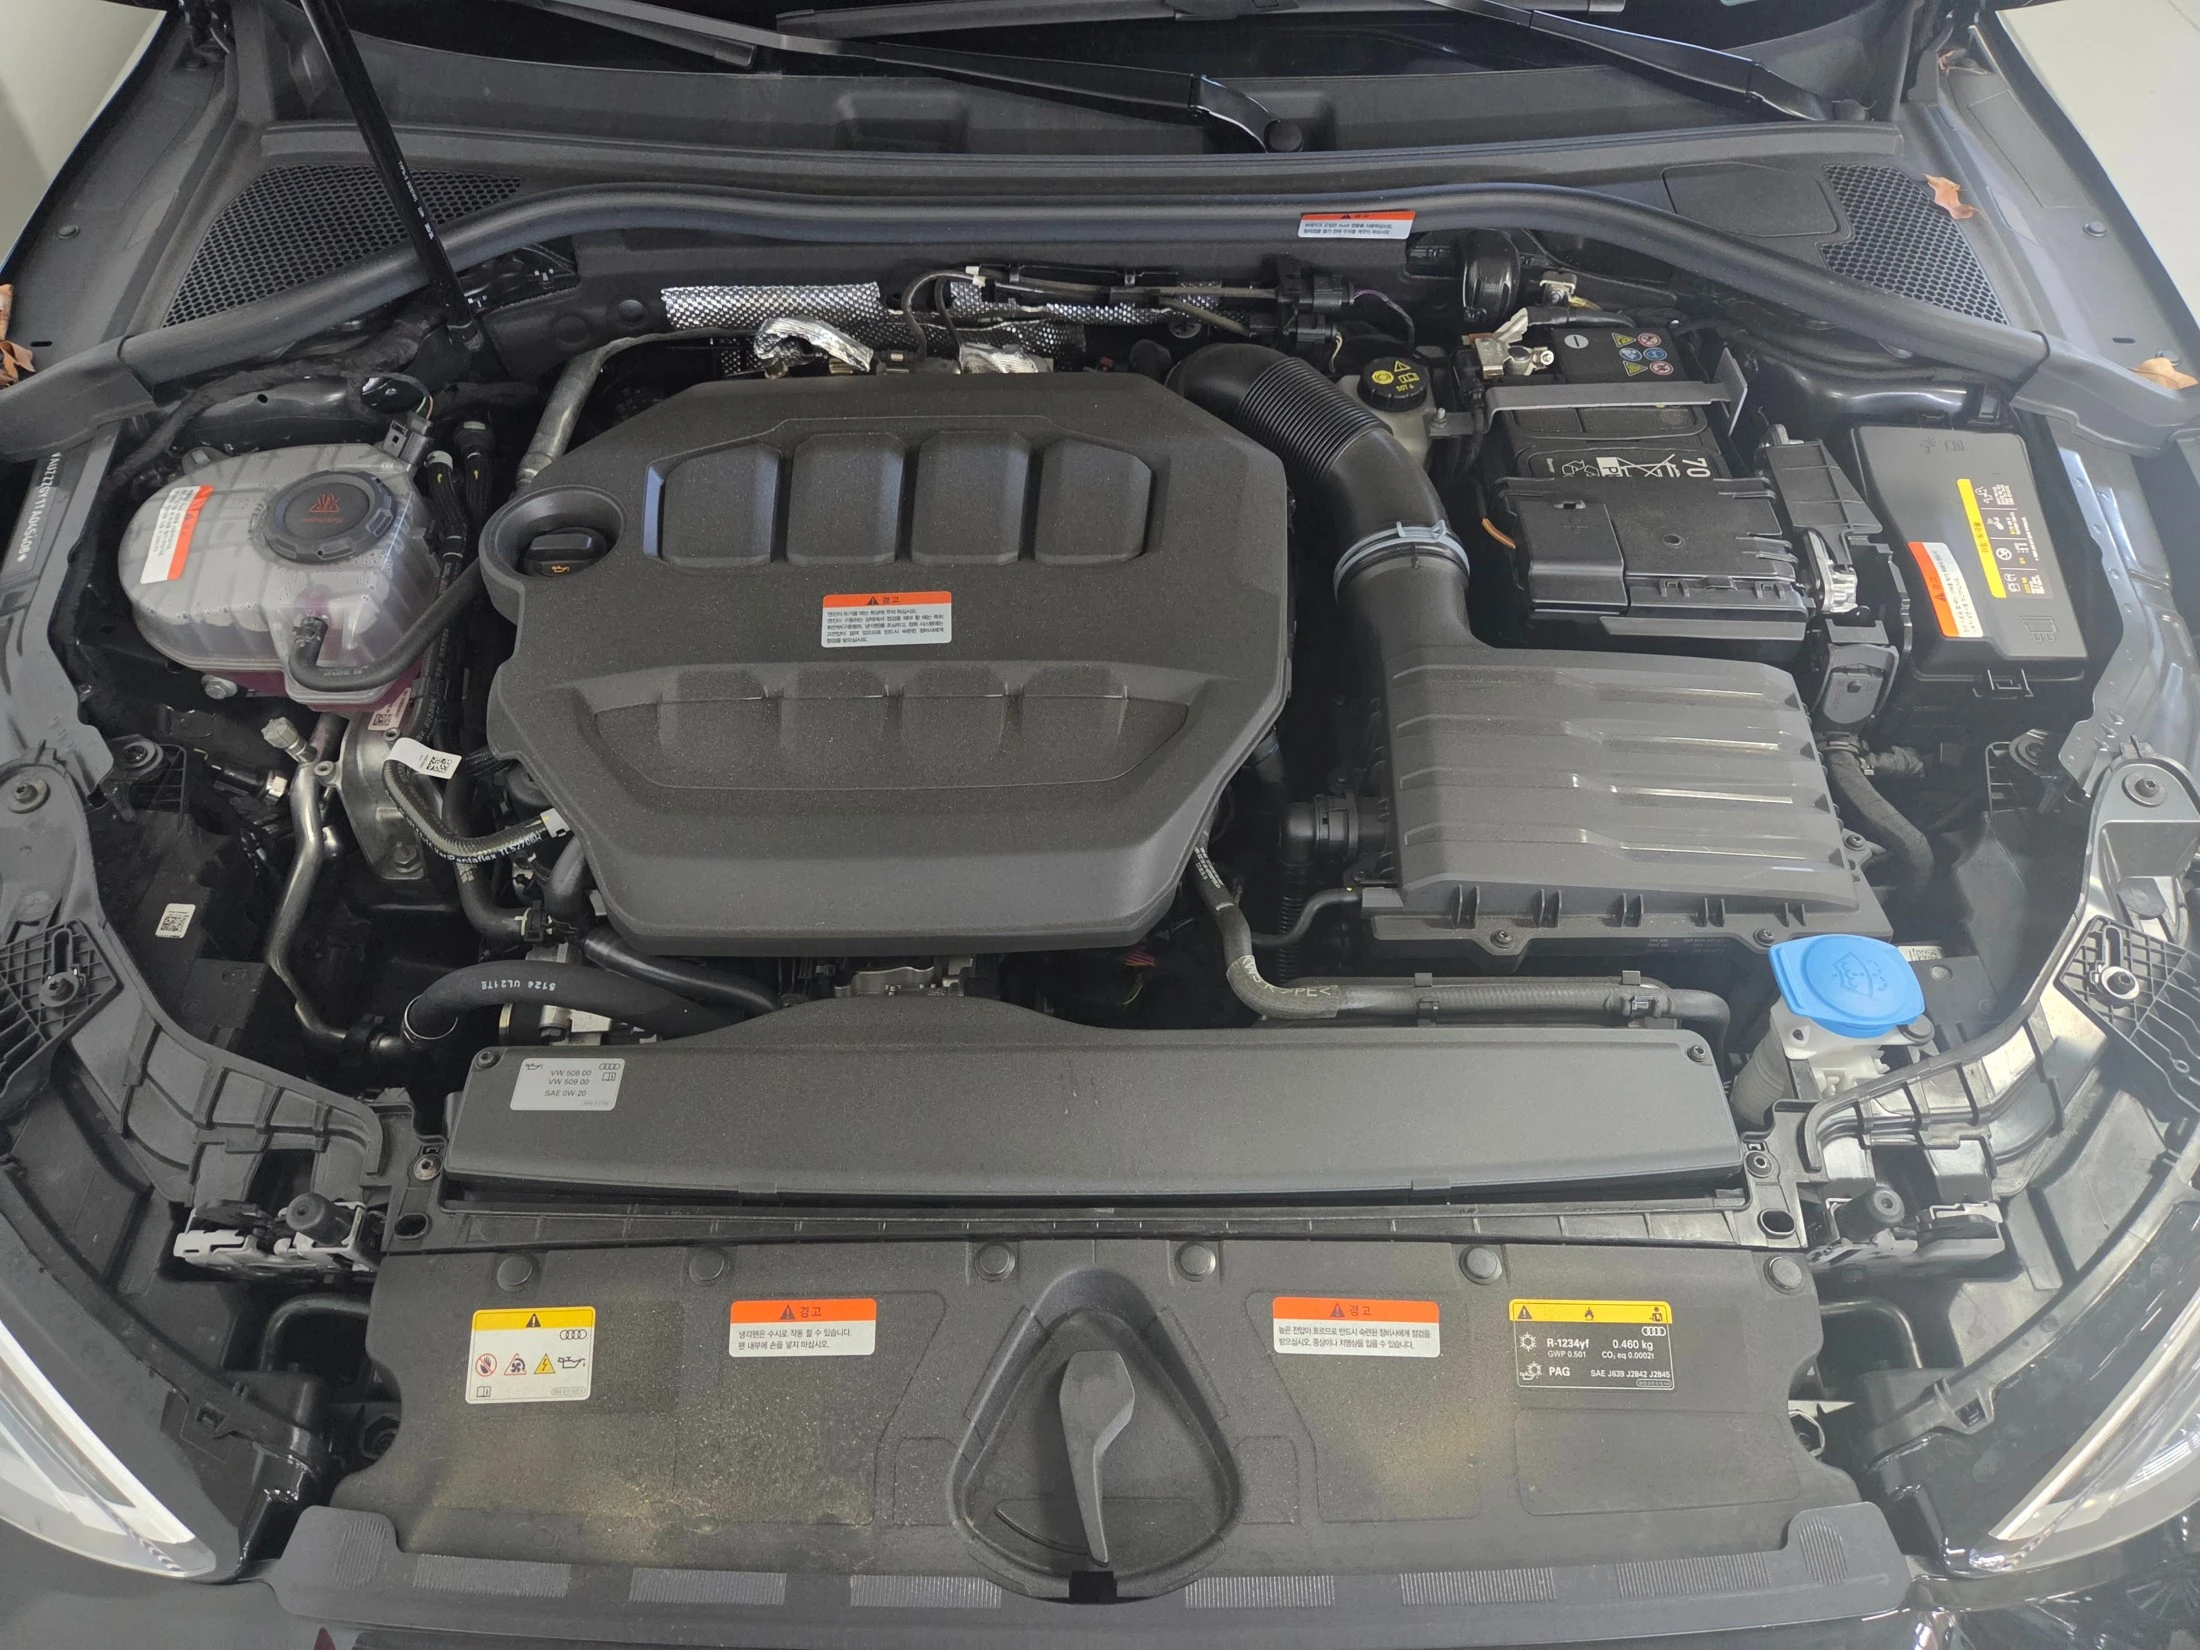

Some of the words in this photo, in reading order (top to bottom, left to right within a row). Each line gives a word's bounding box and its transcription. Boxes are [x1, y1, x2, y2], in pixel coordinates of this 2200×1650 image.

[800, 1306, 822, 1318] 경고
[1350, 1305, 1372, 1316] 경고
[738, 1330, 765, 1339] 냉각팬은
[767, 1329, 788, 1338] 수시로
[790, 1329, 803, 1338] 작동
[806, 1329, 813, 1337] 할
[823, 1328, 852, 1337] 있습니다.
[1278, 1326, 1291, 1335] 높은
[1293, 1326, 1312, 1335] 전압이
[1313, 1327, 1338, 1336] 흐르므로
[1339, 1327, 1358, 1336] 반드시
[1359, 1328, 1378, 1337] 숙련된
[1379, 1328, 1410, 1338] 정비사에게
[1411, 1329, 1431, 1338] 점검을
[738, 1341, 745, 1350] 팬
[748, 1341, 768, 1350] 내부에
[769, 1341, 783, 1350] 손을
[785, 1341, 799, 1349] 넣지
[801, 1340, 830, 1349] 마십시오.
[1312, 1338, 1338, 1347] 중상이나
[1339, 1339, 1364, 1348] 치명상을
[1365, 1339, 1378, 1348] 입을
[1379, 1340, 1387, 1348] 수
[1388, 1340, 1414, 1349] 있습니다.
[1546, 1338, 1590, 1350] R-1234yf
[1612, 1339, 1639, 1349] 0.460
[1642, 1340, 1654, 1351] kg
[1548, 1367, 1570, 1376] PAG
